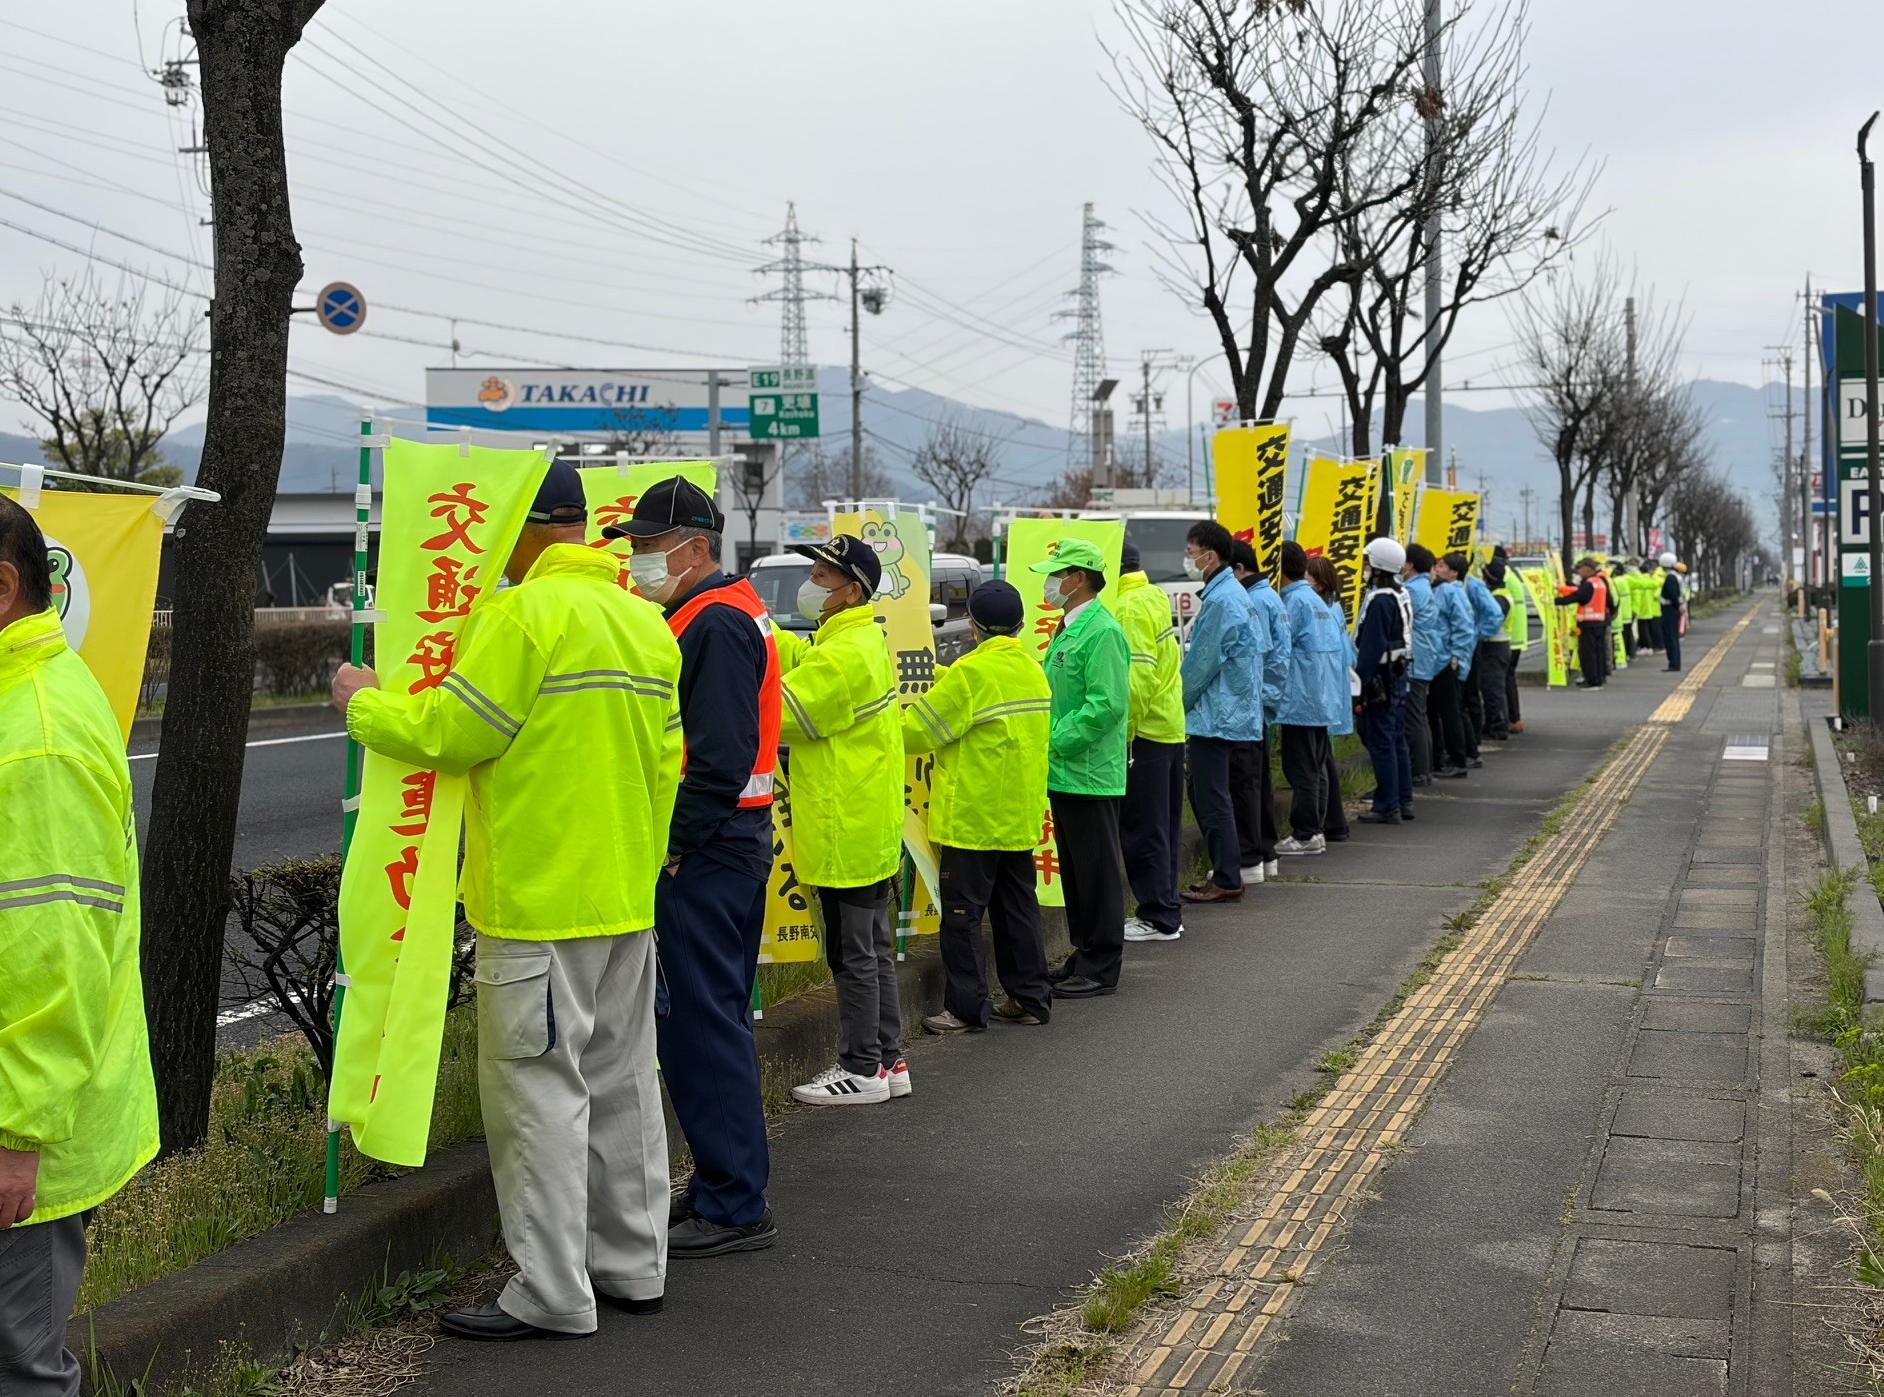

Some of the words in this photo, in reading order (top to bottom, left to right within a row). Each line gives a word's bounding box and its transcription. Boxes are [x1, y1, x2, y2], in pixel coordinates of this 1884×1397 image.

[752, 373, 778, 387] E19
[521, 383, 650, 406] TAKACHI
[1446, 501, 1477, 554] 交通
